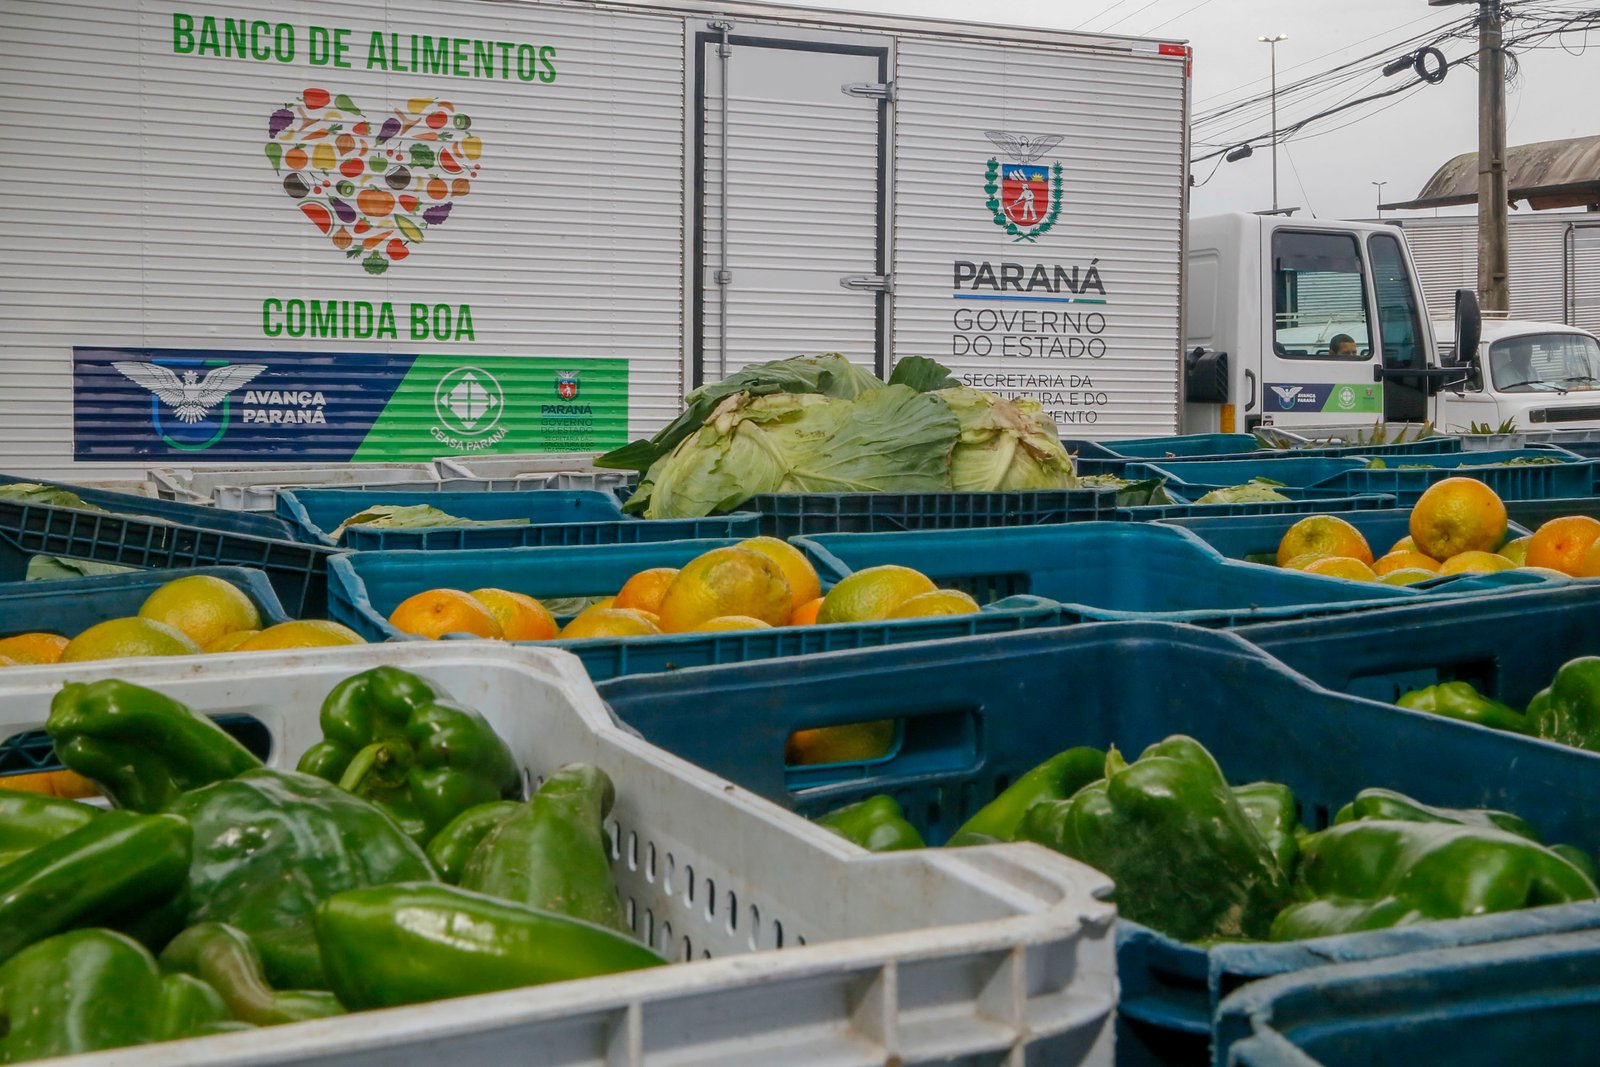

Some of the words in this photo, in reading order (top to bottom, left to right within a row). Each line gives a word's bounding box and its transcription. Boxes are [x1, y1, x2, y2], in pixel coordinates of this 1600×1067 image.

[172, 12, 295, 64] BANCO
[309, 26, 352, 68] DE
[366, 31, 557, 84] ALIMENTOS
[953, 258, 1107, 295] PARANÁ
[262, 298, 398, 340] COMIDA
[410, 303, 475, 342] BOA
[953, 308, 1106, 334] GOVERNO
[953, 334, 993, 357] DO
[1002, 335, 1107, 359] ESTADO
[963, 373, 1065, 388] SECRETARIA
[1070, 375, 1093, 388] DA
[243, 390, 327, 406] AVANÇA
[541, 402, 593, 415] PARANÁ
[1070, 393, 1079, 405] E
[1084, 392, 1108, 406] DO
[243, 405, 327, 424] PARANÁ
[541, 418, 593, 427] GOVERNO
[430, 426, 464, 451] CEASA
